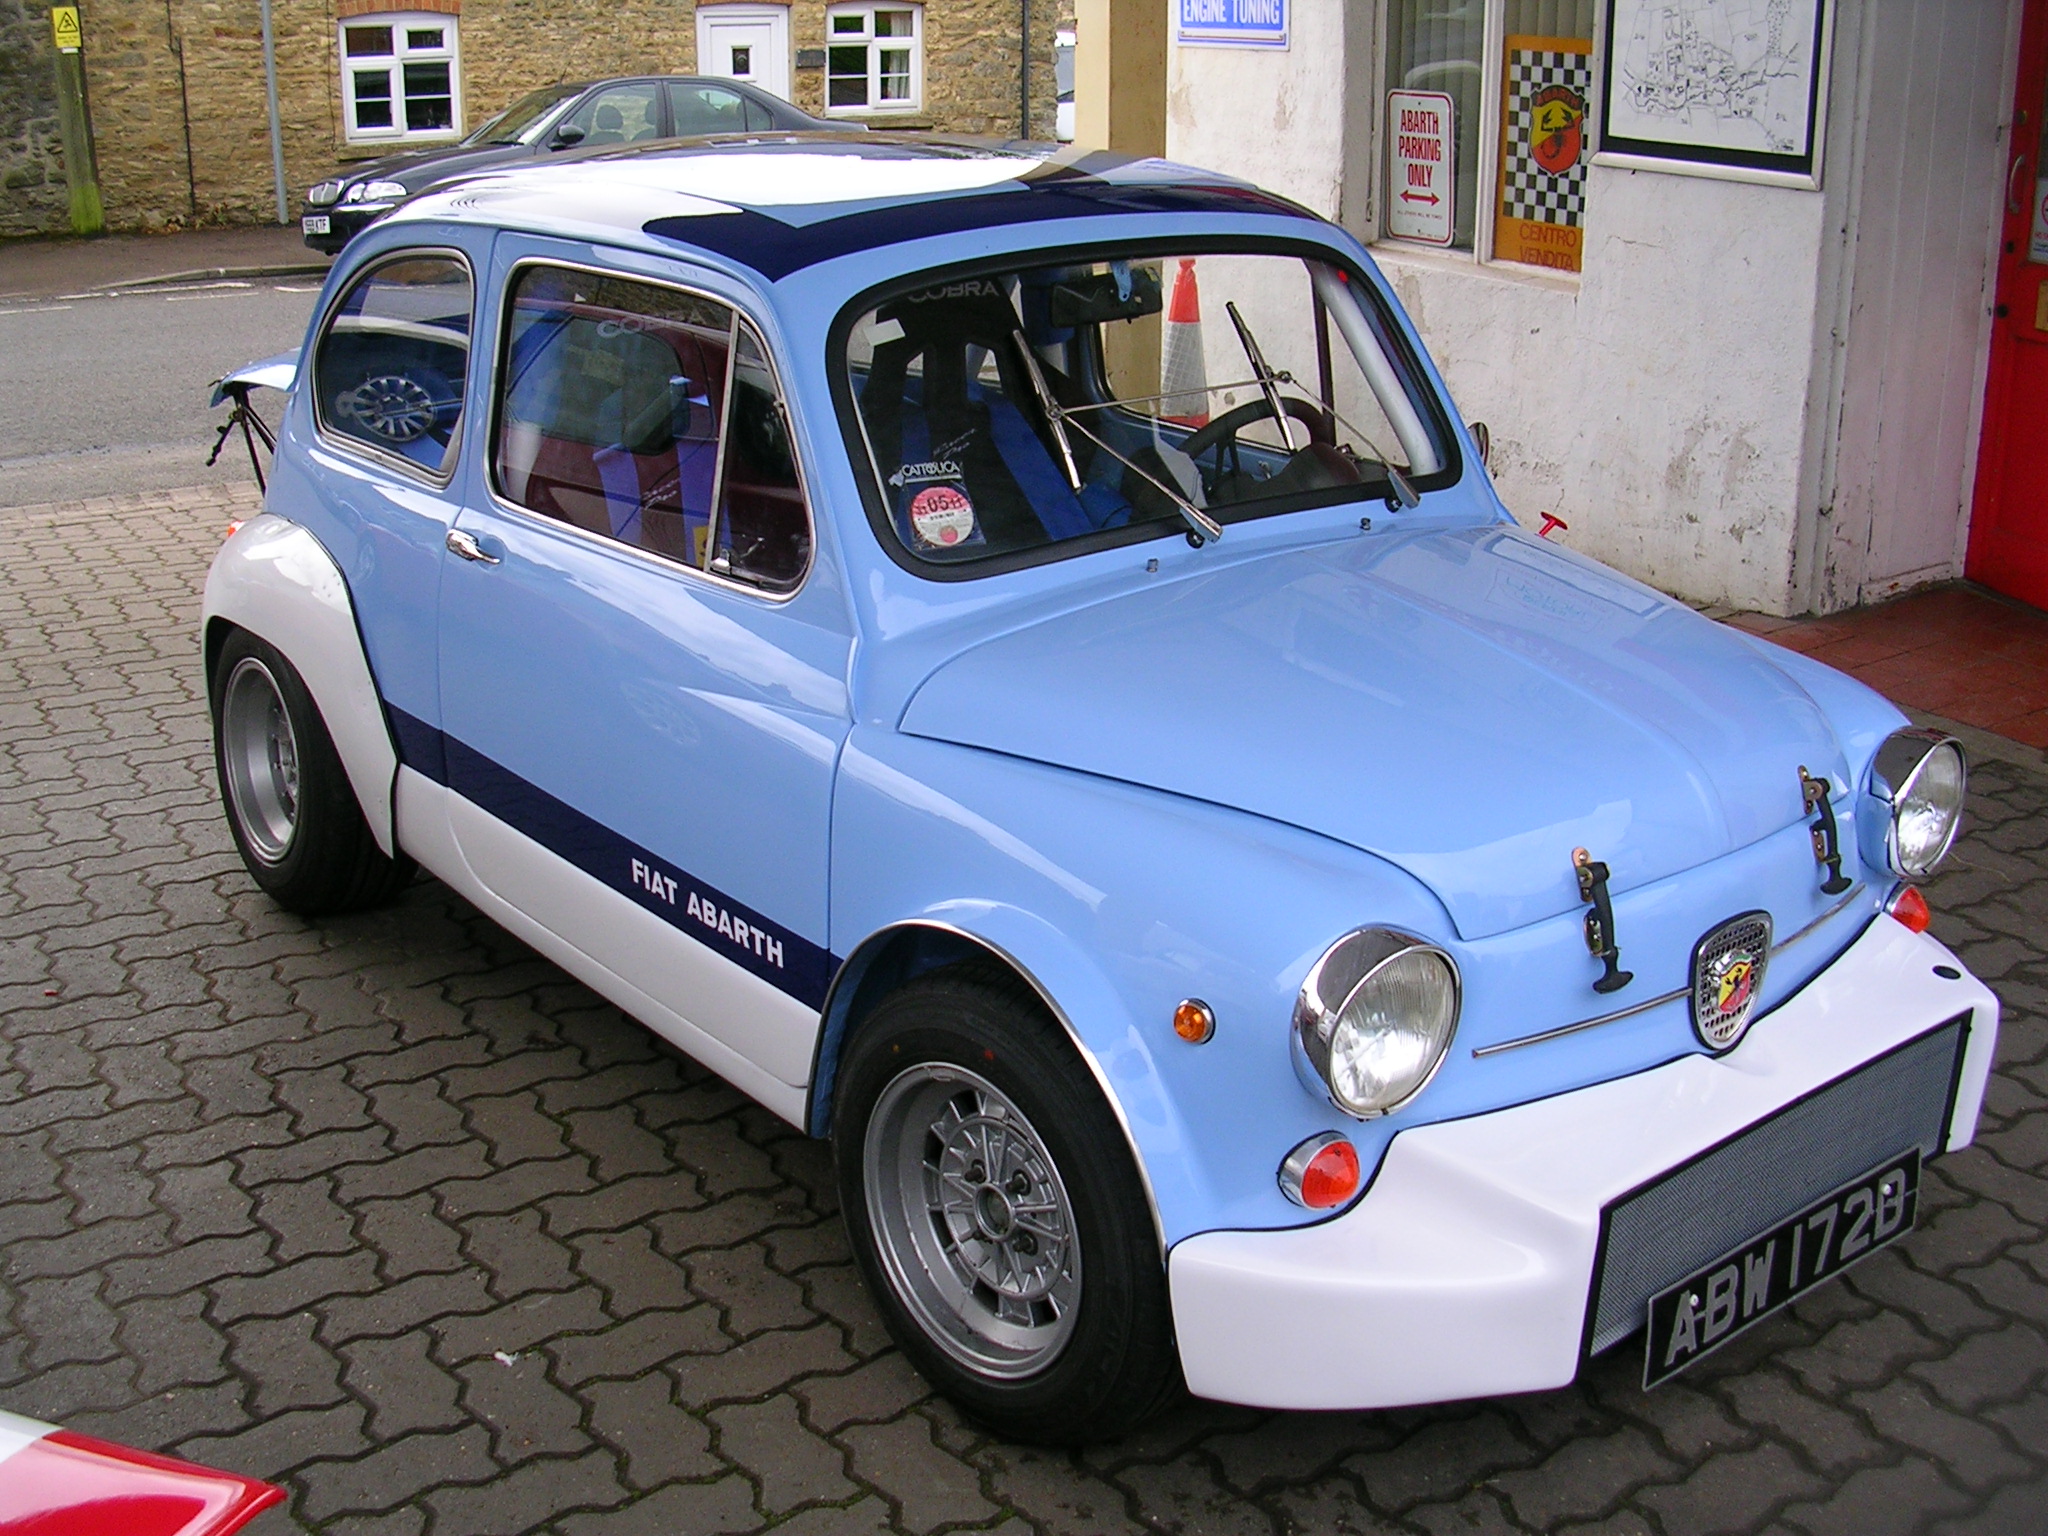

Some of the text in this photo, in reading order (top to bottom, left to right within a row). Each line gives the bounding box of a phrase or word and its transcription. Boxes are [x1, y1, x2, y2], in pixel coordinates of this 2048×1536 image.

[1183, 0, 1280, 24] ENGINE TUNING
[1400, 109, 1439, 135] ABARTH
[1398, 135, 1442, 162] PARKING
[1407, 163, 1433, 188] ONLY
[1519, 223, 1577, 248] CENTRO
[1519, 246, 1575, 271] VENDITA
[901, 460, 961, 477] CATTOLICA
[631, 857, 784, 968] FIAT ABARTH
[1664, 1167, 1906, 1367] ABW 172B
